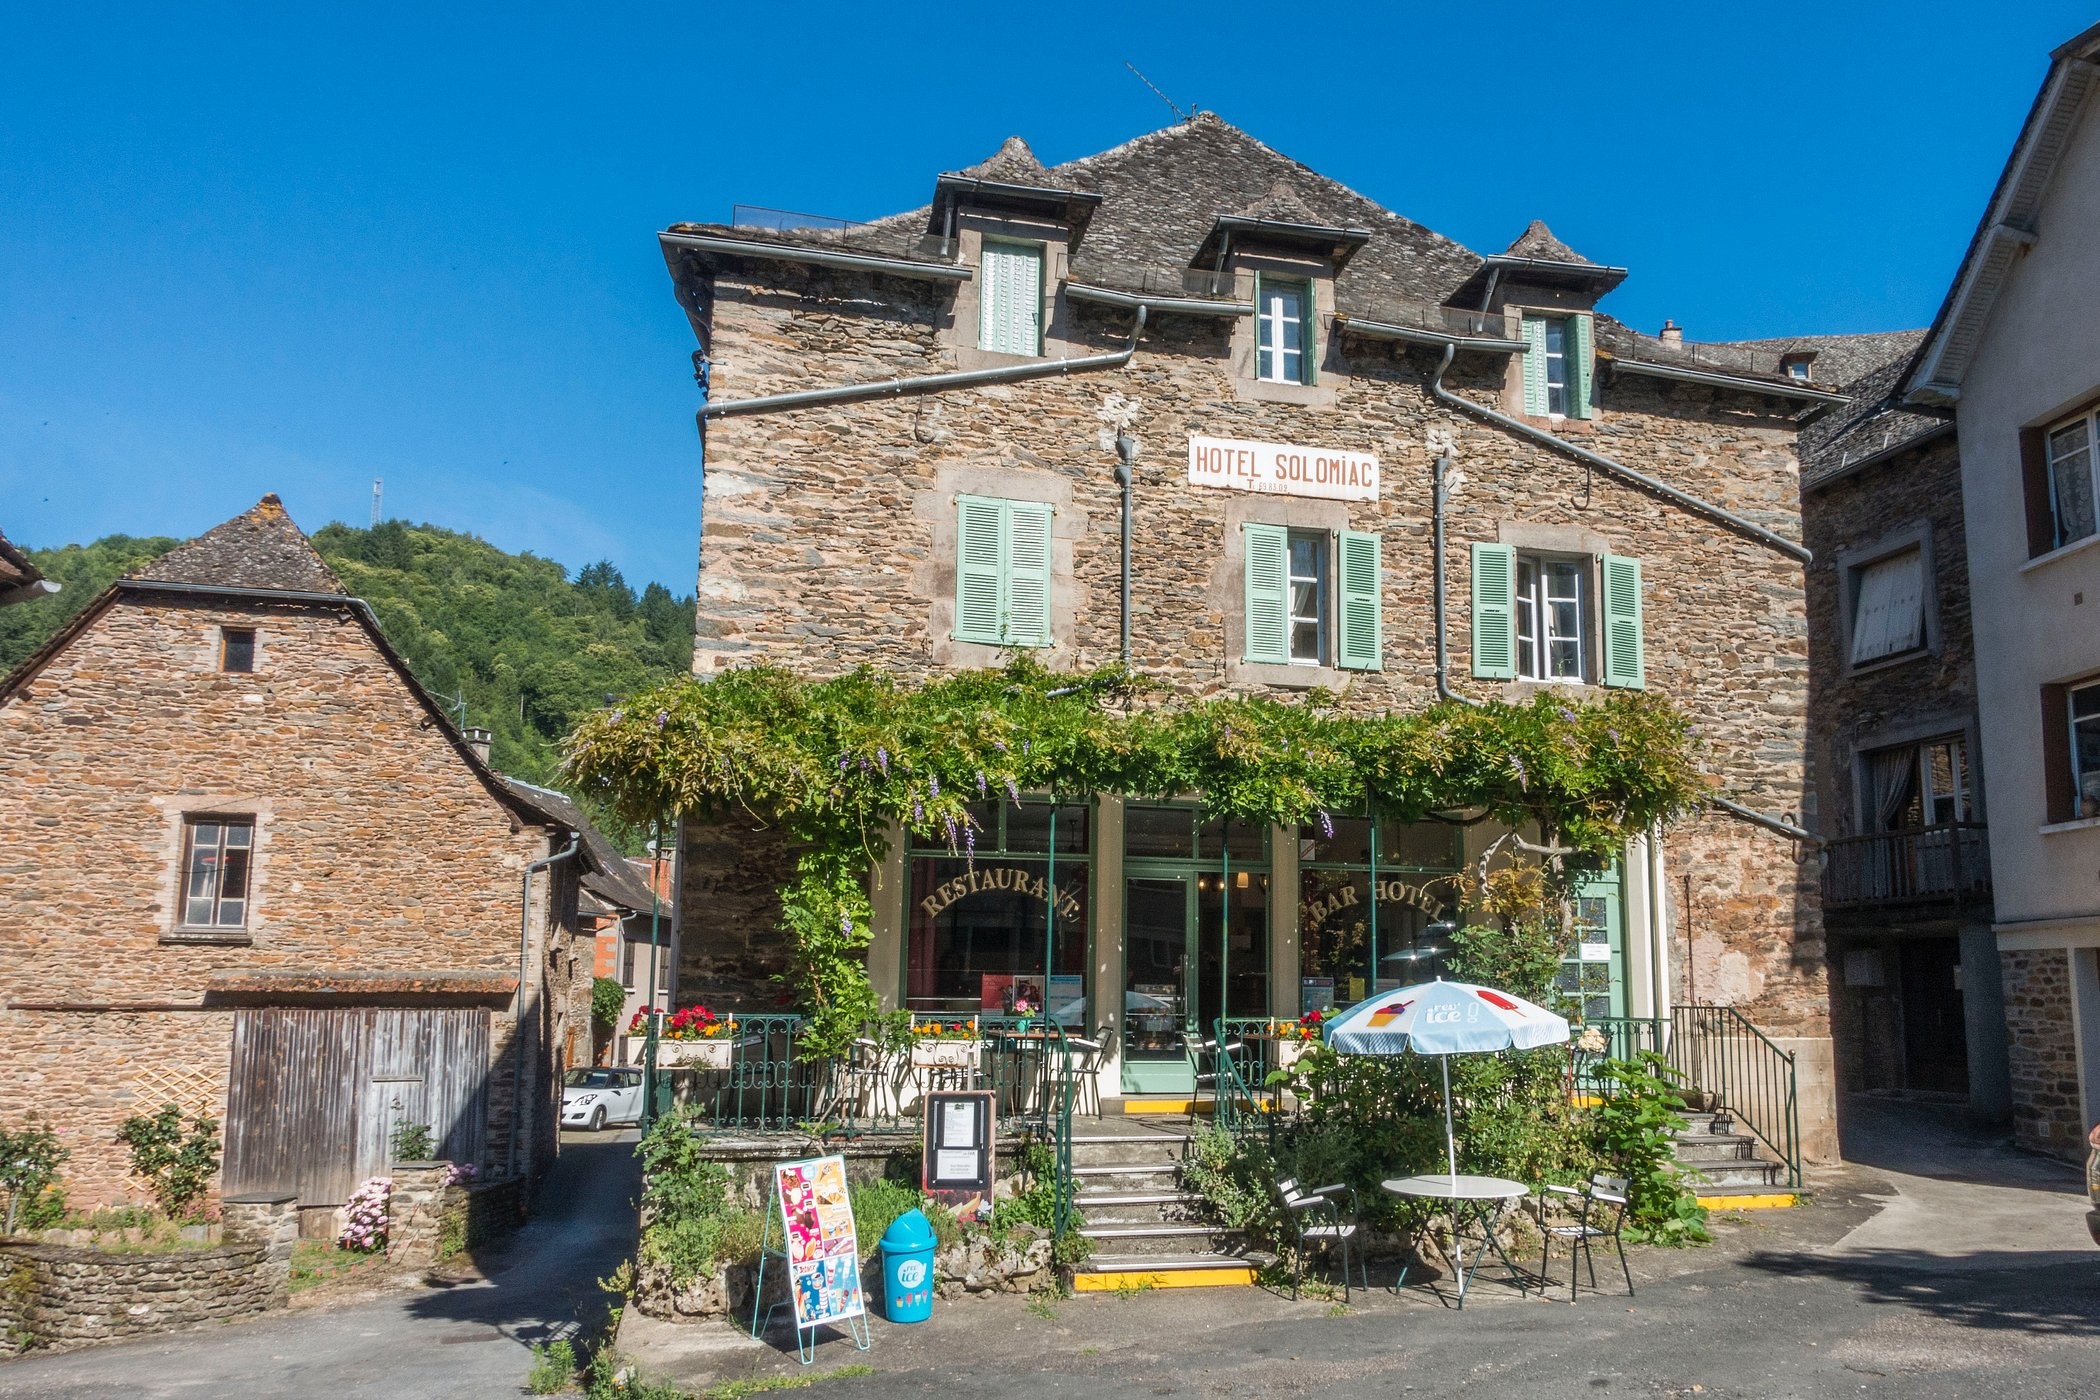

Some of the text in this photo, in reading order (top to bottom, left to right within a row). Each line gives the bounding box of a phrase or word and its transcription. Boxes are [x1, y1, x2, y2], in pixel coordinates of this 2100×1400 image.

[1196, 445, 1262, 478] HOTEL
[920, 868, 1081, 919] RESTAURANT
[1309, 880, 1445, 924] BAR HOTEL
[1425, 1007, 1462, 1025] ice
[901, 1269, 919, 1282] ice
